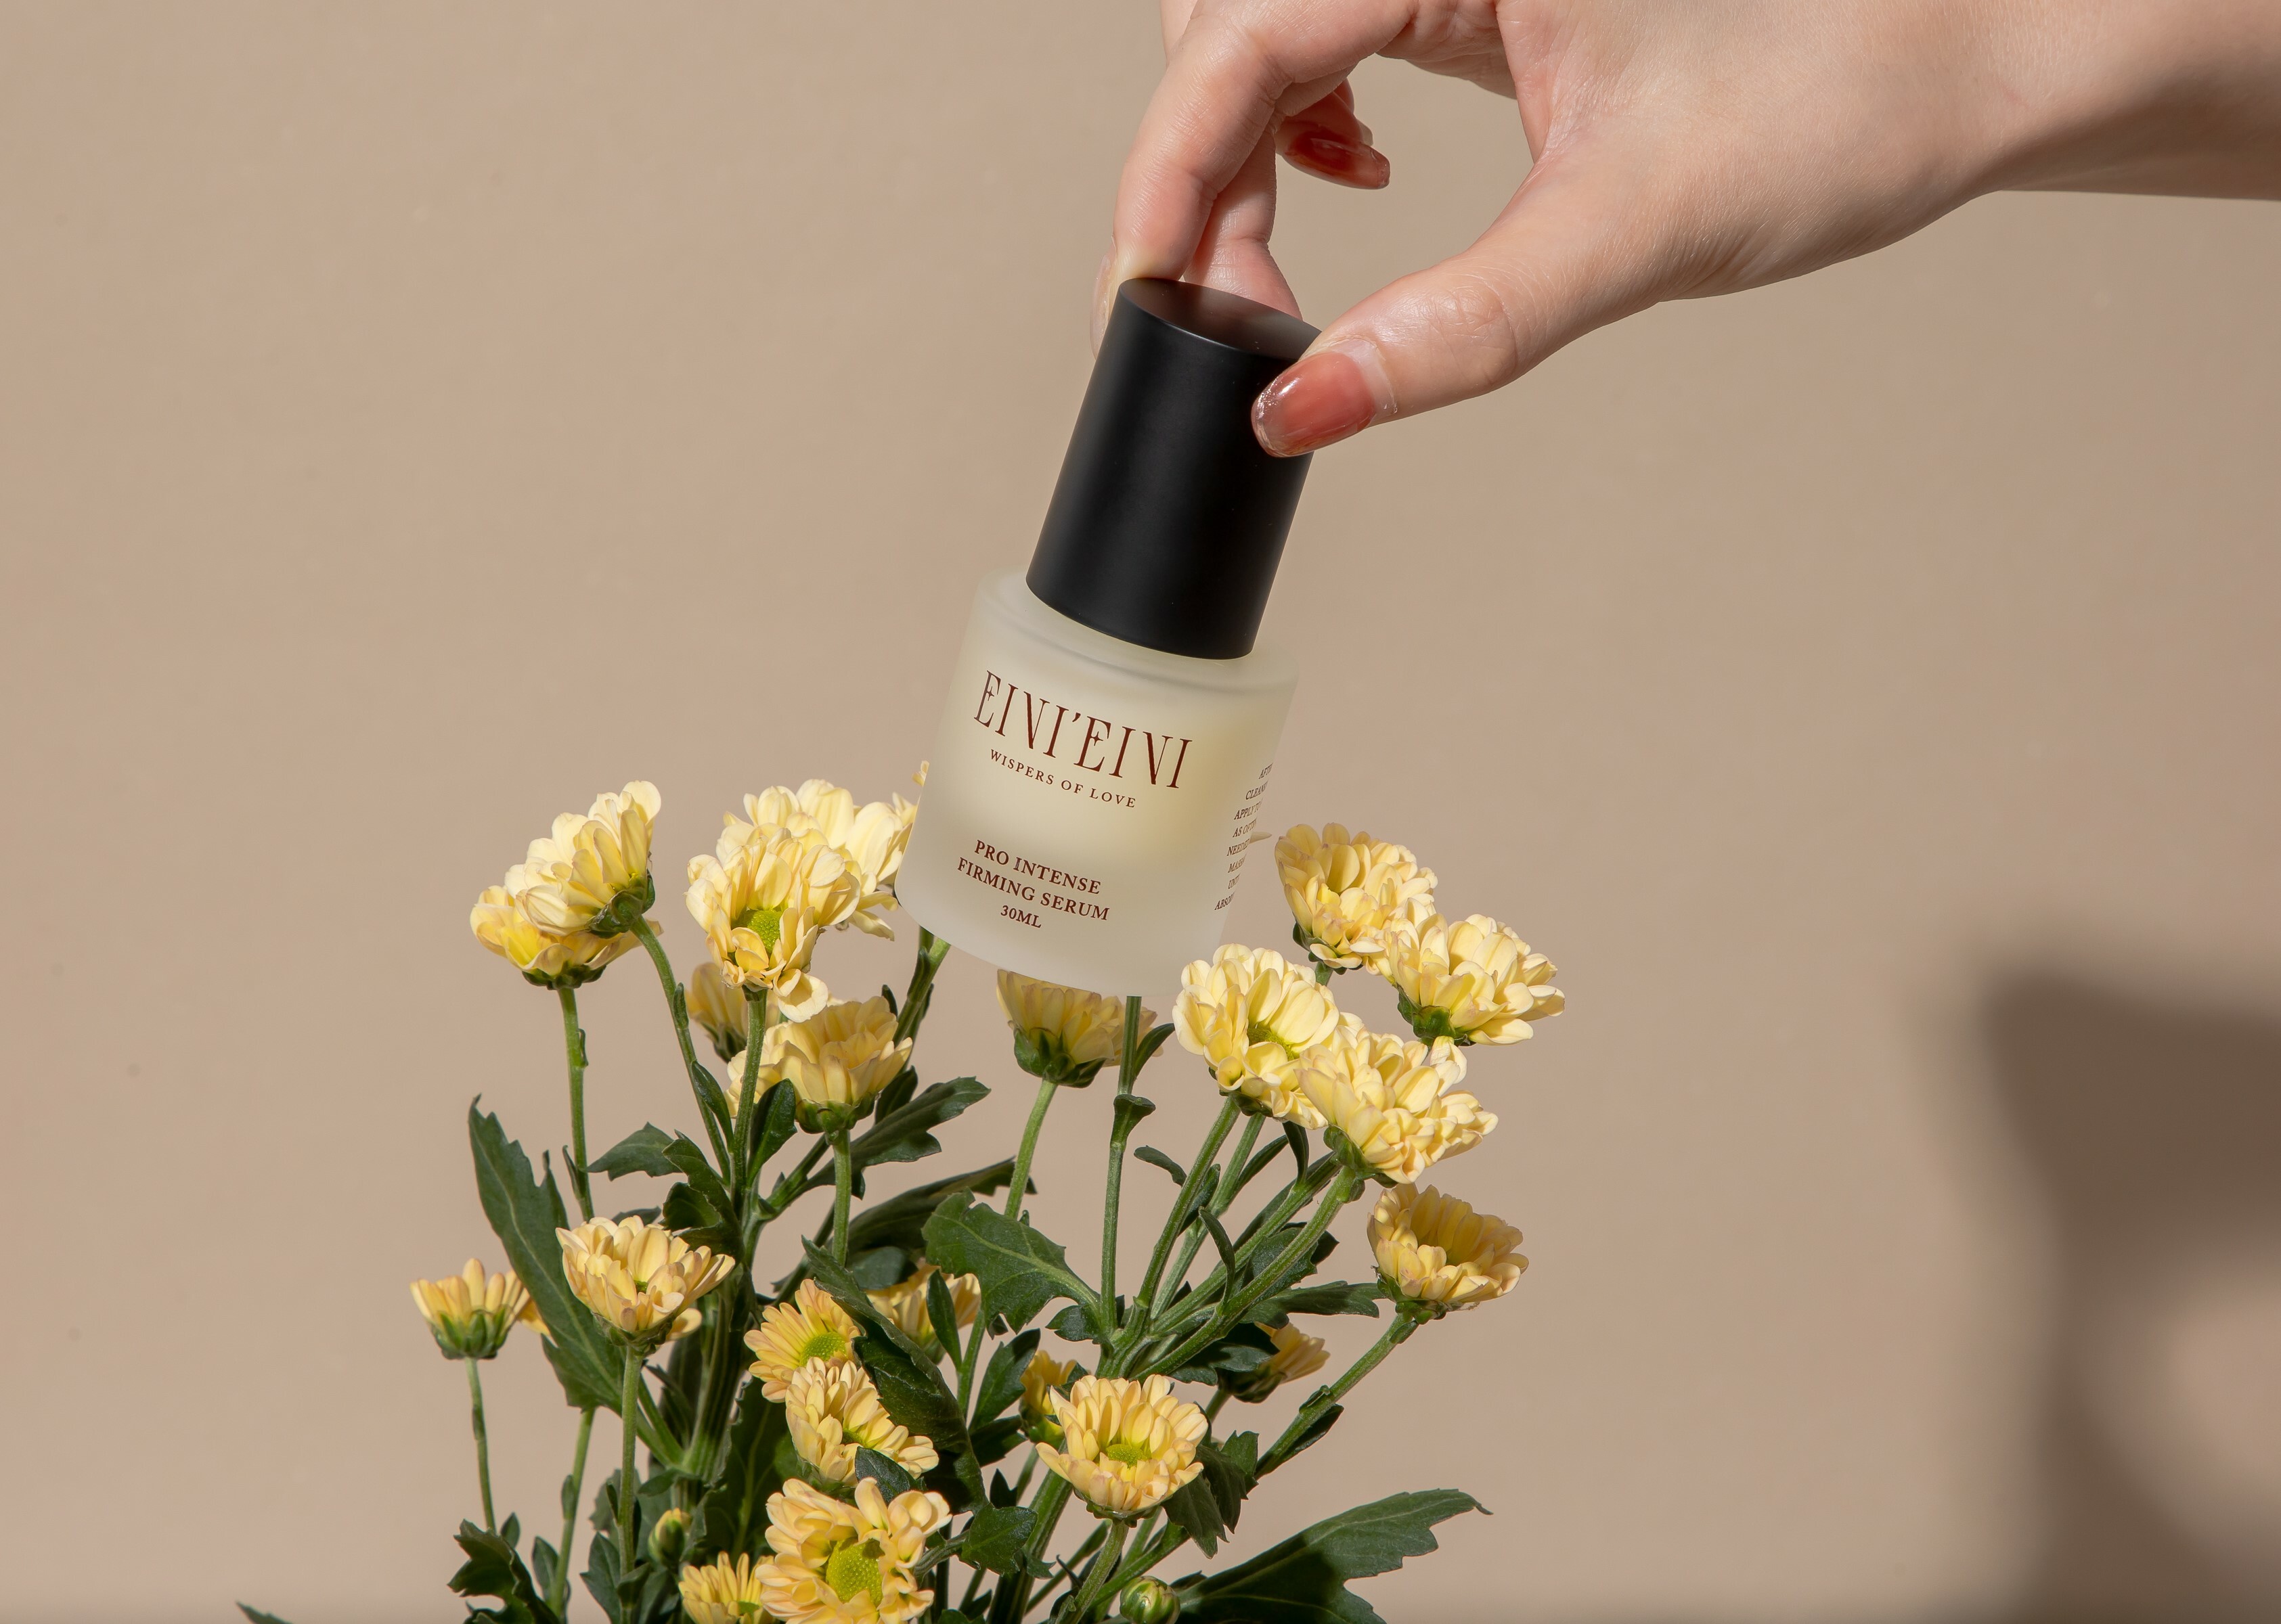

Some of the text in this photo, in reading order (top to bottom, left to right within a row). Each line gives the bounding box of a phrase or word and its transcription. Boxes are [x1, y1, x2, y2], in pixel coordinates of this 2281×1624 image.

[990, 748, 1136, 809] WISPERS OF LOVE
[1233, 826, 1243, 838] AS
[956, 857, 1110, 921] FIRMING SERUM
[974, 839, 1102, 895] PRO INTENSE
[1000, 905, 1042, 928] 30ML
